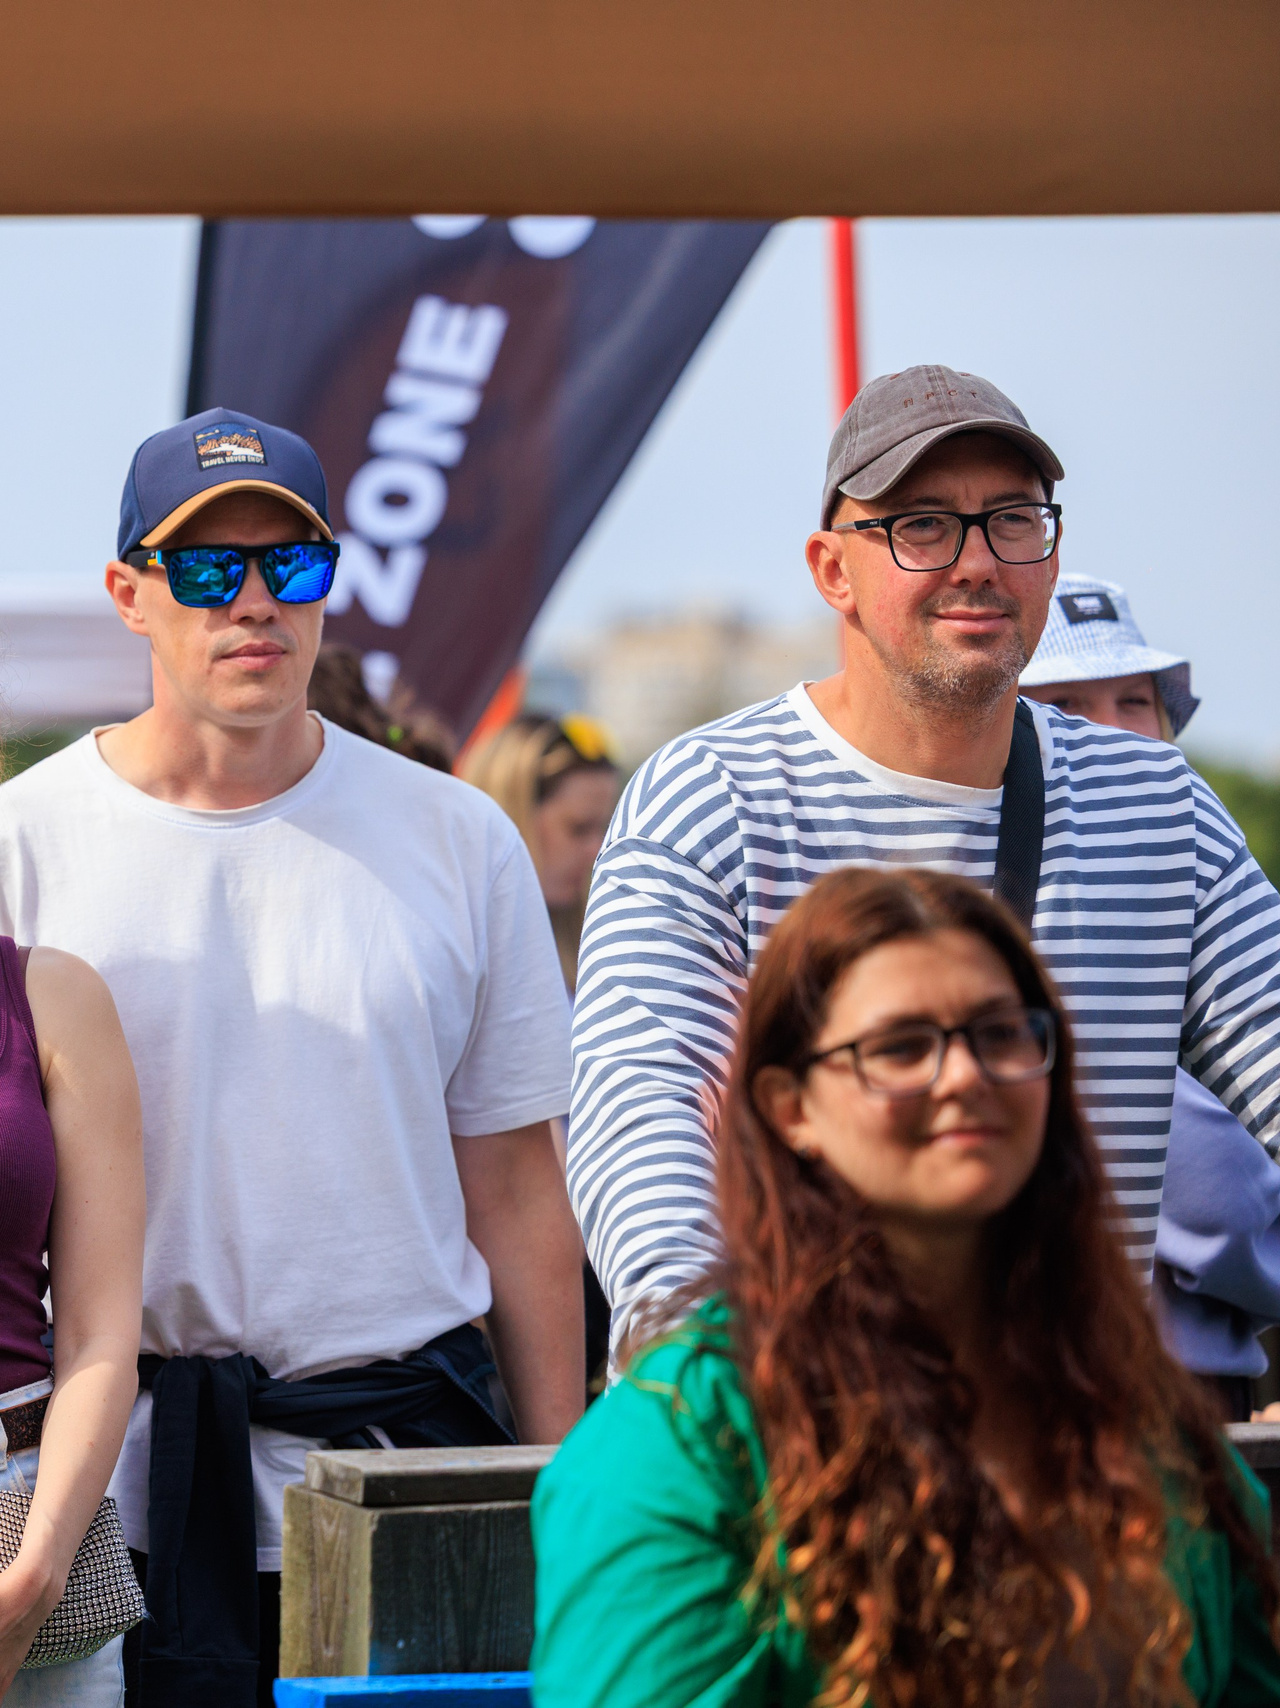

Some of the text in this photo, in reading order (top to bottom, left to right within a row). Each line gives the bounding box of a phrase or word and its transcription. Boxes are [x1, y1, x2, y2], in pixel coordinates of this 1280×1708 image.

[201, 456, 225, 469] TRAVEL
[225, 455, 247, 463] NEVER
[323, 294, 508, 628] ZONE
